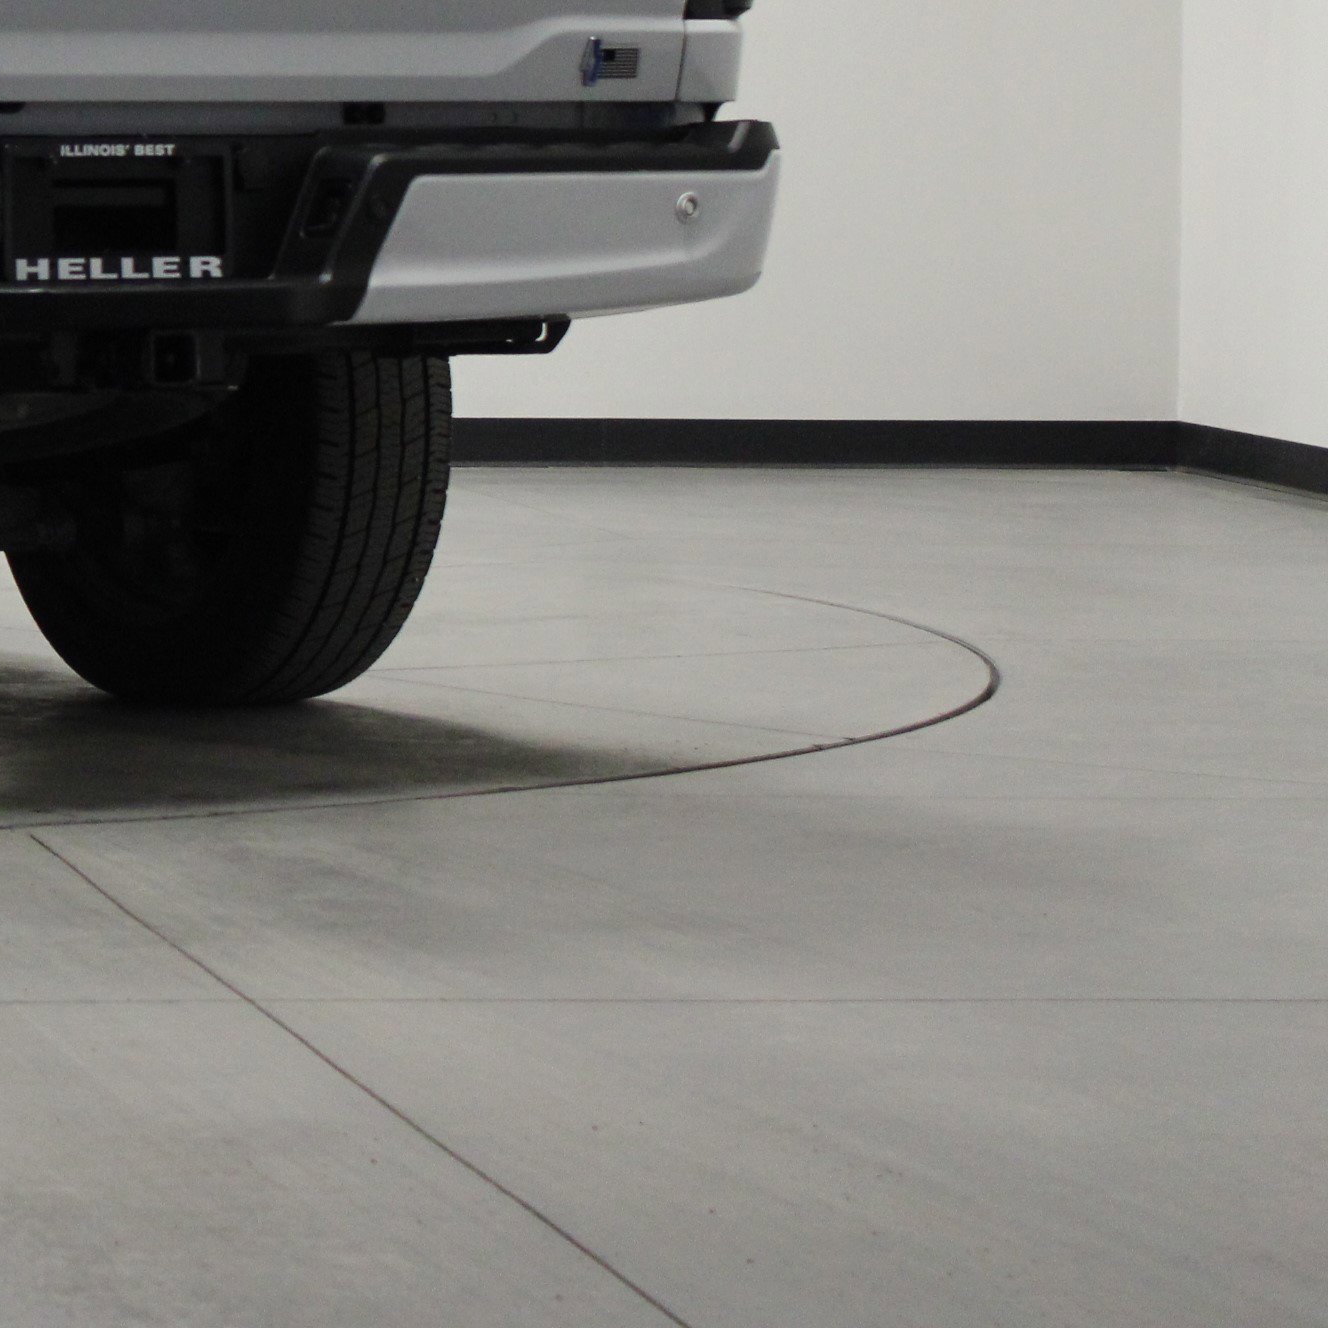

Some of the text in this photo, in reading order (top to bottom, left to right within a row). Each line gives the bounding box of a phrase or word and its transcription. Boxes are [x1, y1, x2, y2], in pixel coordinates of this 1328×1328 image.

[60, 143, 175, 157] ILLINOIS' BEST
[15, 256, 223, 281] HELLER
